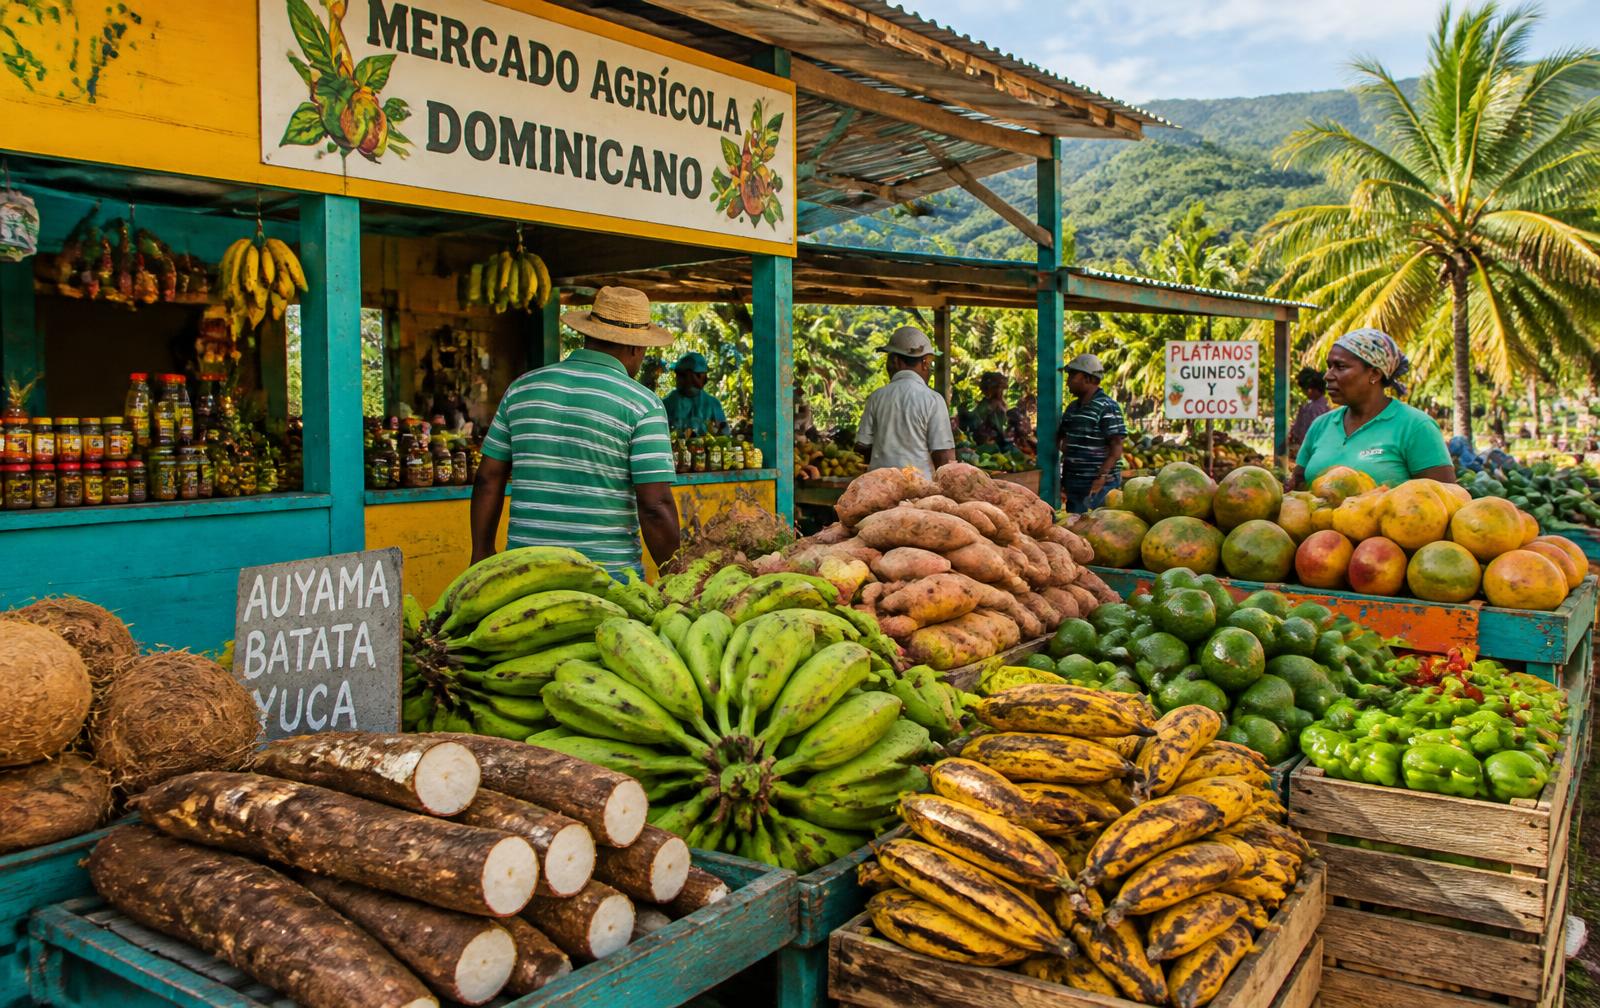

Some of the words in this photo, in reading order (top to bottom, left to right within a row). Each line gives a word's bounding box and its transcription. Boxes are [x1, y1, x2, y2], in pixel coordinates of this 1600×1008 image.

[367, 0, 579, 93] MERCADO
[590, 60, 742, 136] AGRÍCOLA
[426, 100, 702, 200] DOMINICANO
[1171, 343, 1253, 362] PLÁTANOS
[1180, 365, 1245, 379] GUINEOS
[1184, 399, 1238, 414] COCOS
[1207, 382, 1217, 396] Y
[243, 560, 390, 622] AUYAMA
[245, 621, 376, 680] BATATA
[253, 680, 357, 732] YUCA
